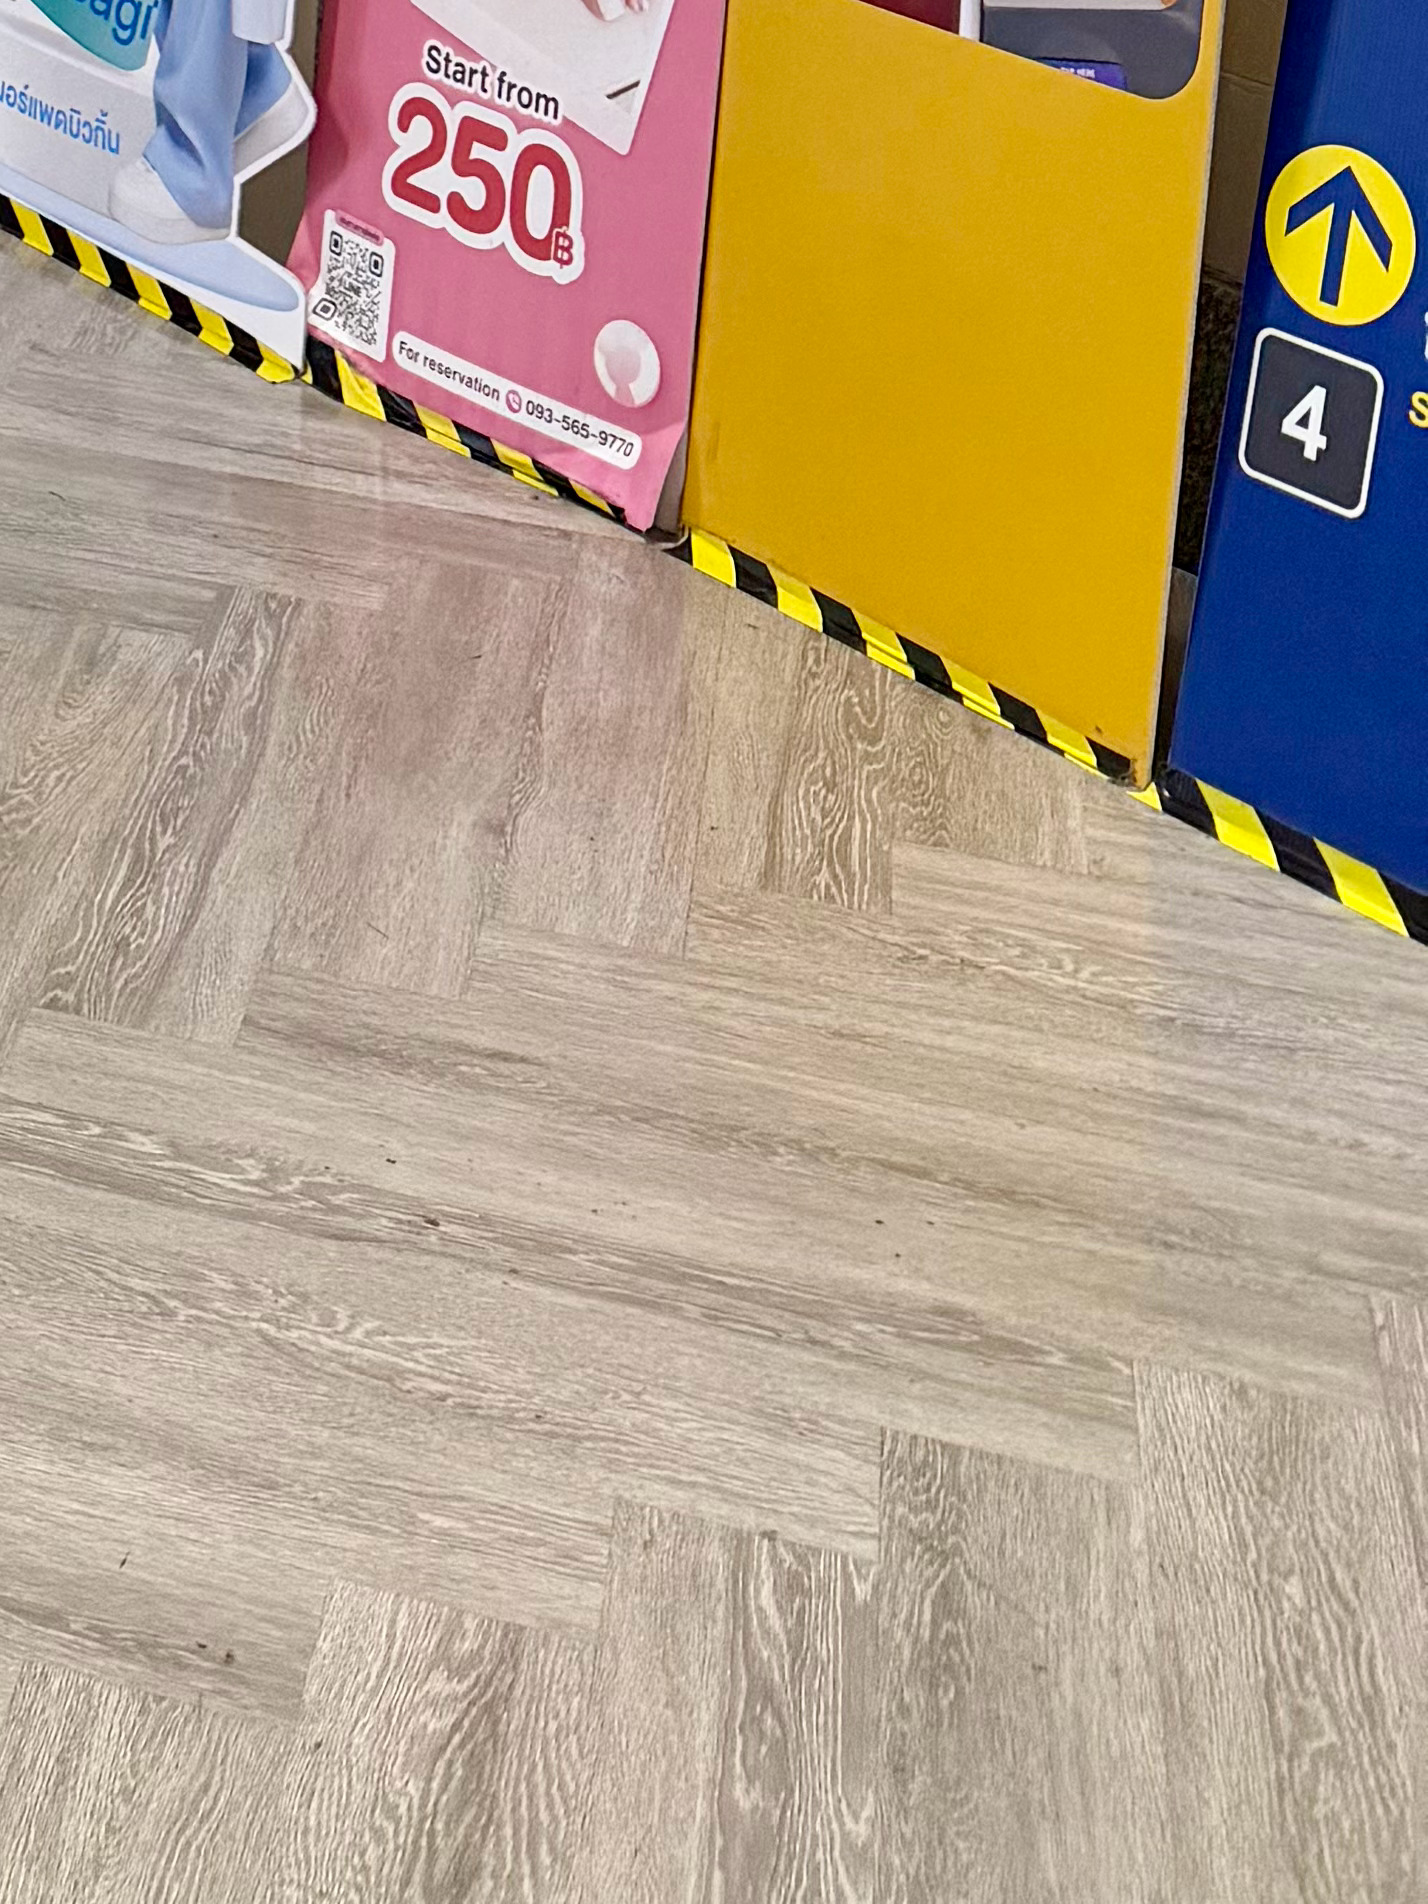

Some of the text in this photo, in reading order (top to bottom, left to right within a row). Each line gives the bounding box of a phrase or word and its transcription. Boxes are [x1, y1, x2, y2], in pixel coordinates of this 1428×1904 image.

[425, 45, 560, 120] Start from
[398, 340, 635, 458] For reservation 093-565-9770
[1280, 385, 1327, 462] 4
